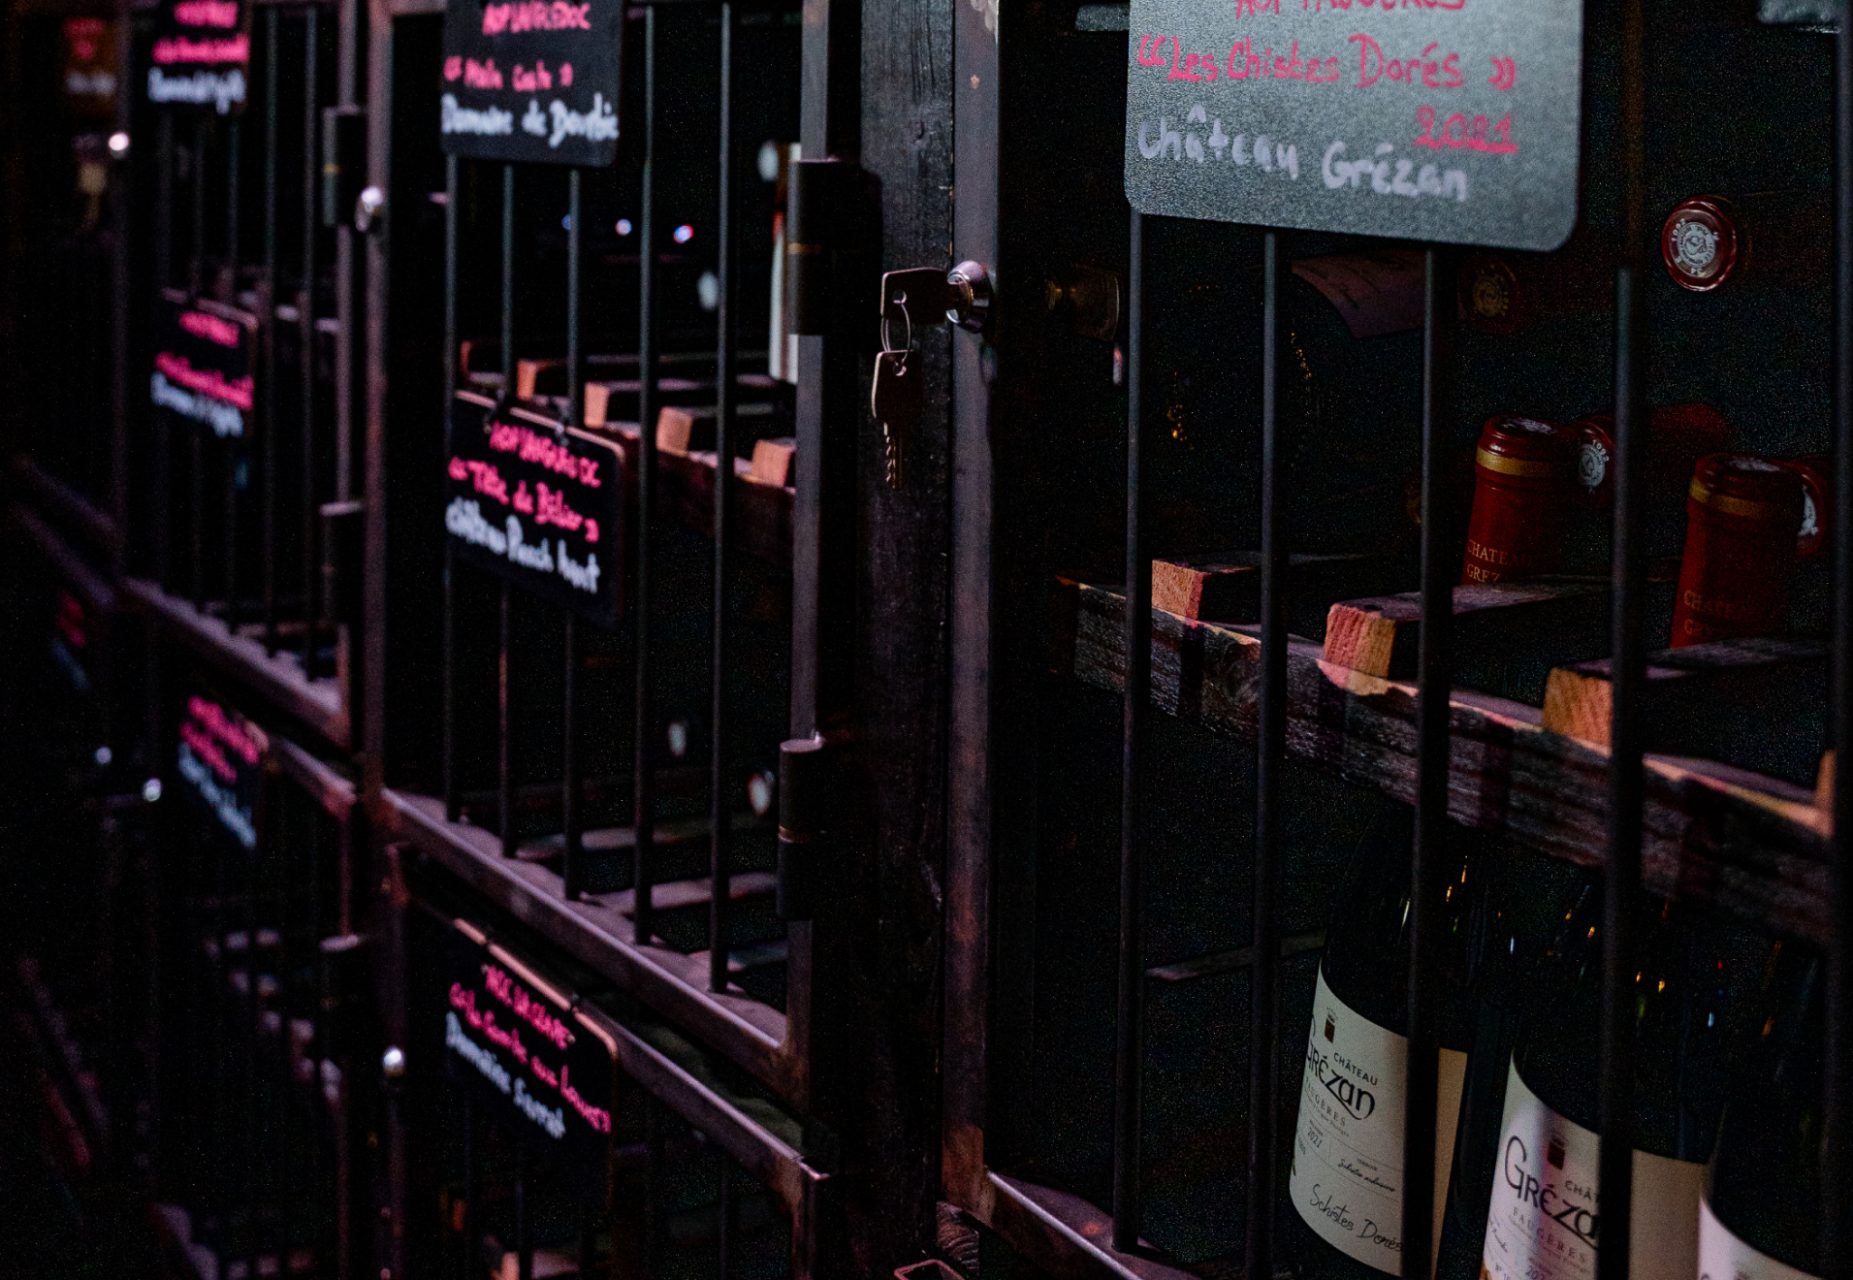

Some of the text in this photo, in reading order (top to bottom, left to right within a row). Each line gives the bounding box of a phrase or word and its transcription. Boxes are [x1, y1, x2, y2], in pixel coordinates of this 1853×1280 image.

[1227, 35, 1340, 83] Chistes
[1348, 34, 1464, 89] Dorés
[1413, 105, 1520, 154] 2021
[1321, 142, 1469, 204] Grézan
[1333, 1052, 1378, 1086] CHÂTEAU
